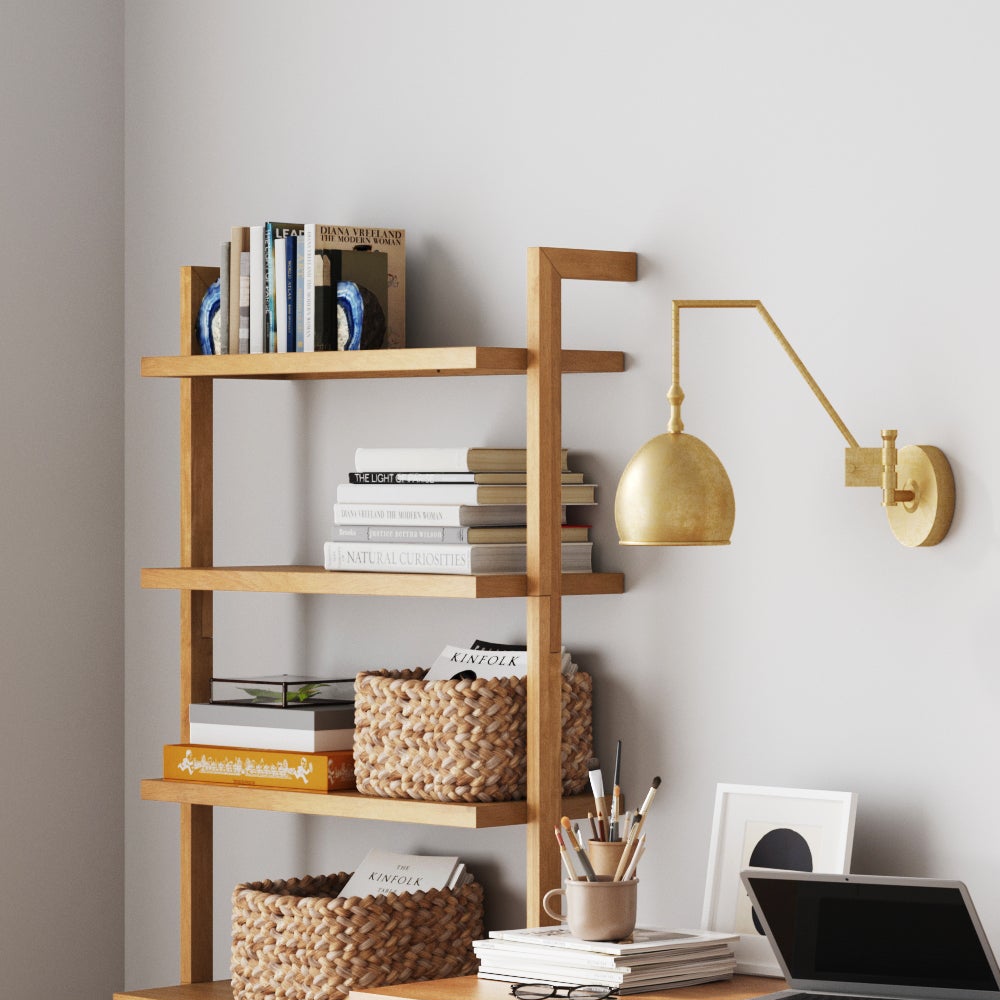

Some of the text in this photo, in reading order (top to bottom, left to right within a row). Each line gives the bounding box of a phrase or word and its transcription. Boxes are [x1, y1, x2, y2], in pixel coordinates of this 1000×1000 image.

[320, 226, 402, 239] DIANA VREELAND
[321, 234, 401, 246] THE MODERN WOMAN
[354, 473, 370, 483] THE
[371, 473, 394, 483] LIGHT
[423, 511, 443, 520] WOMAN
[346, 551, 397, 565] NATURAL
[399, 552, 466, 567] CURIOSITIES
[450, 651, 521, 667] KINFOLK
[368, 871, 424, 887] KINFOLK
